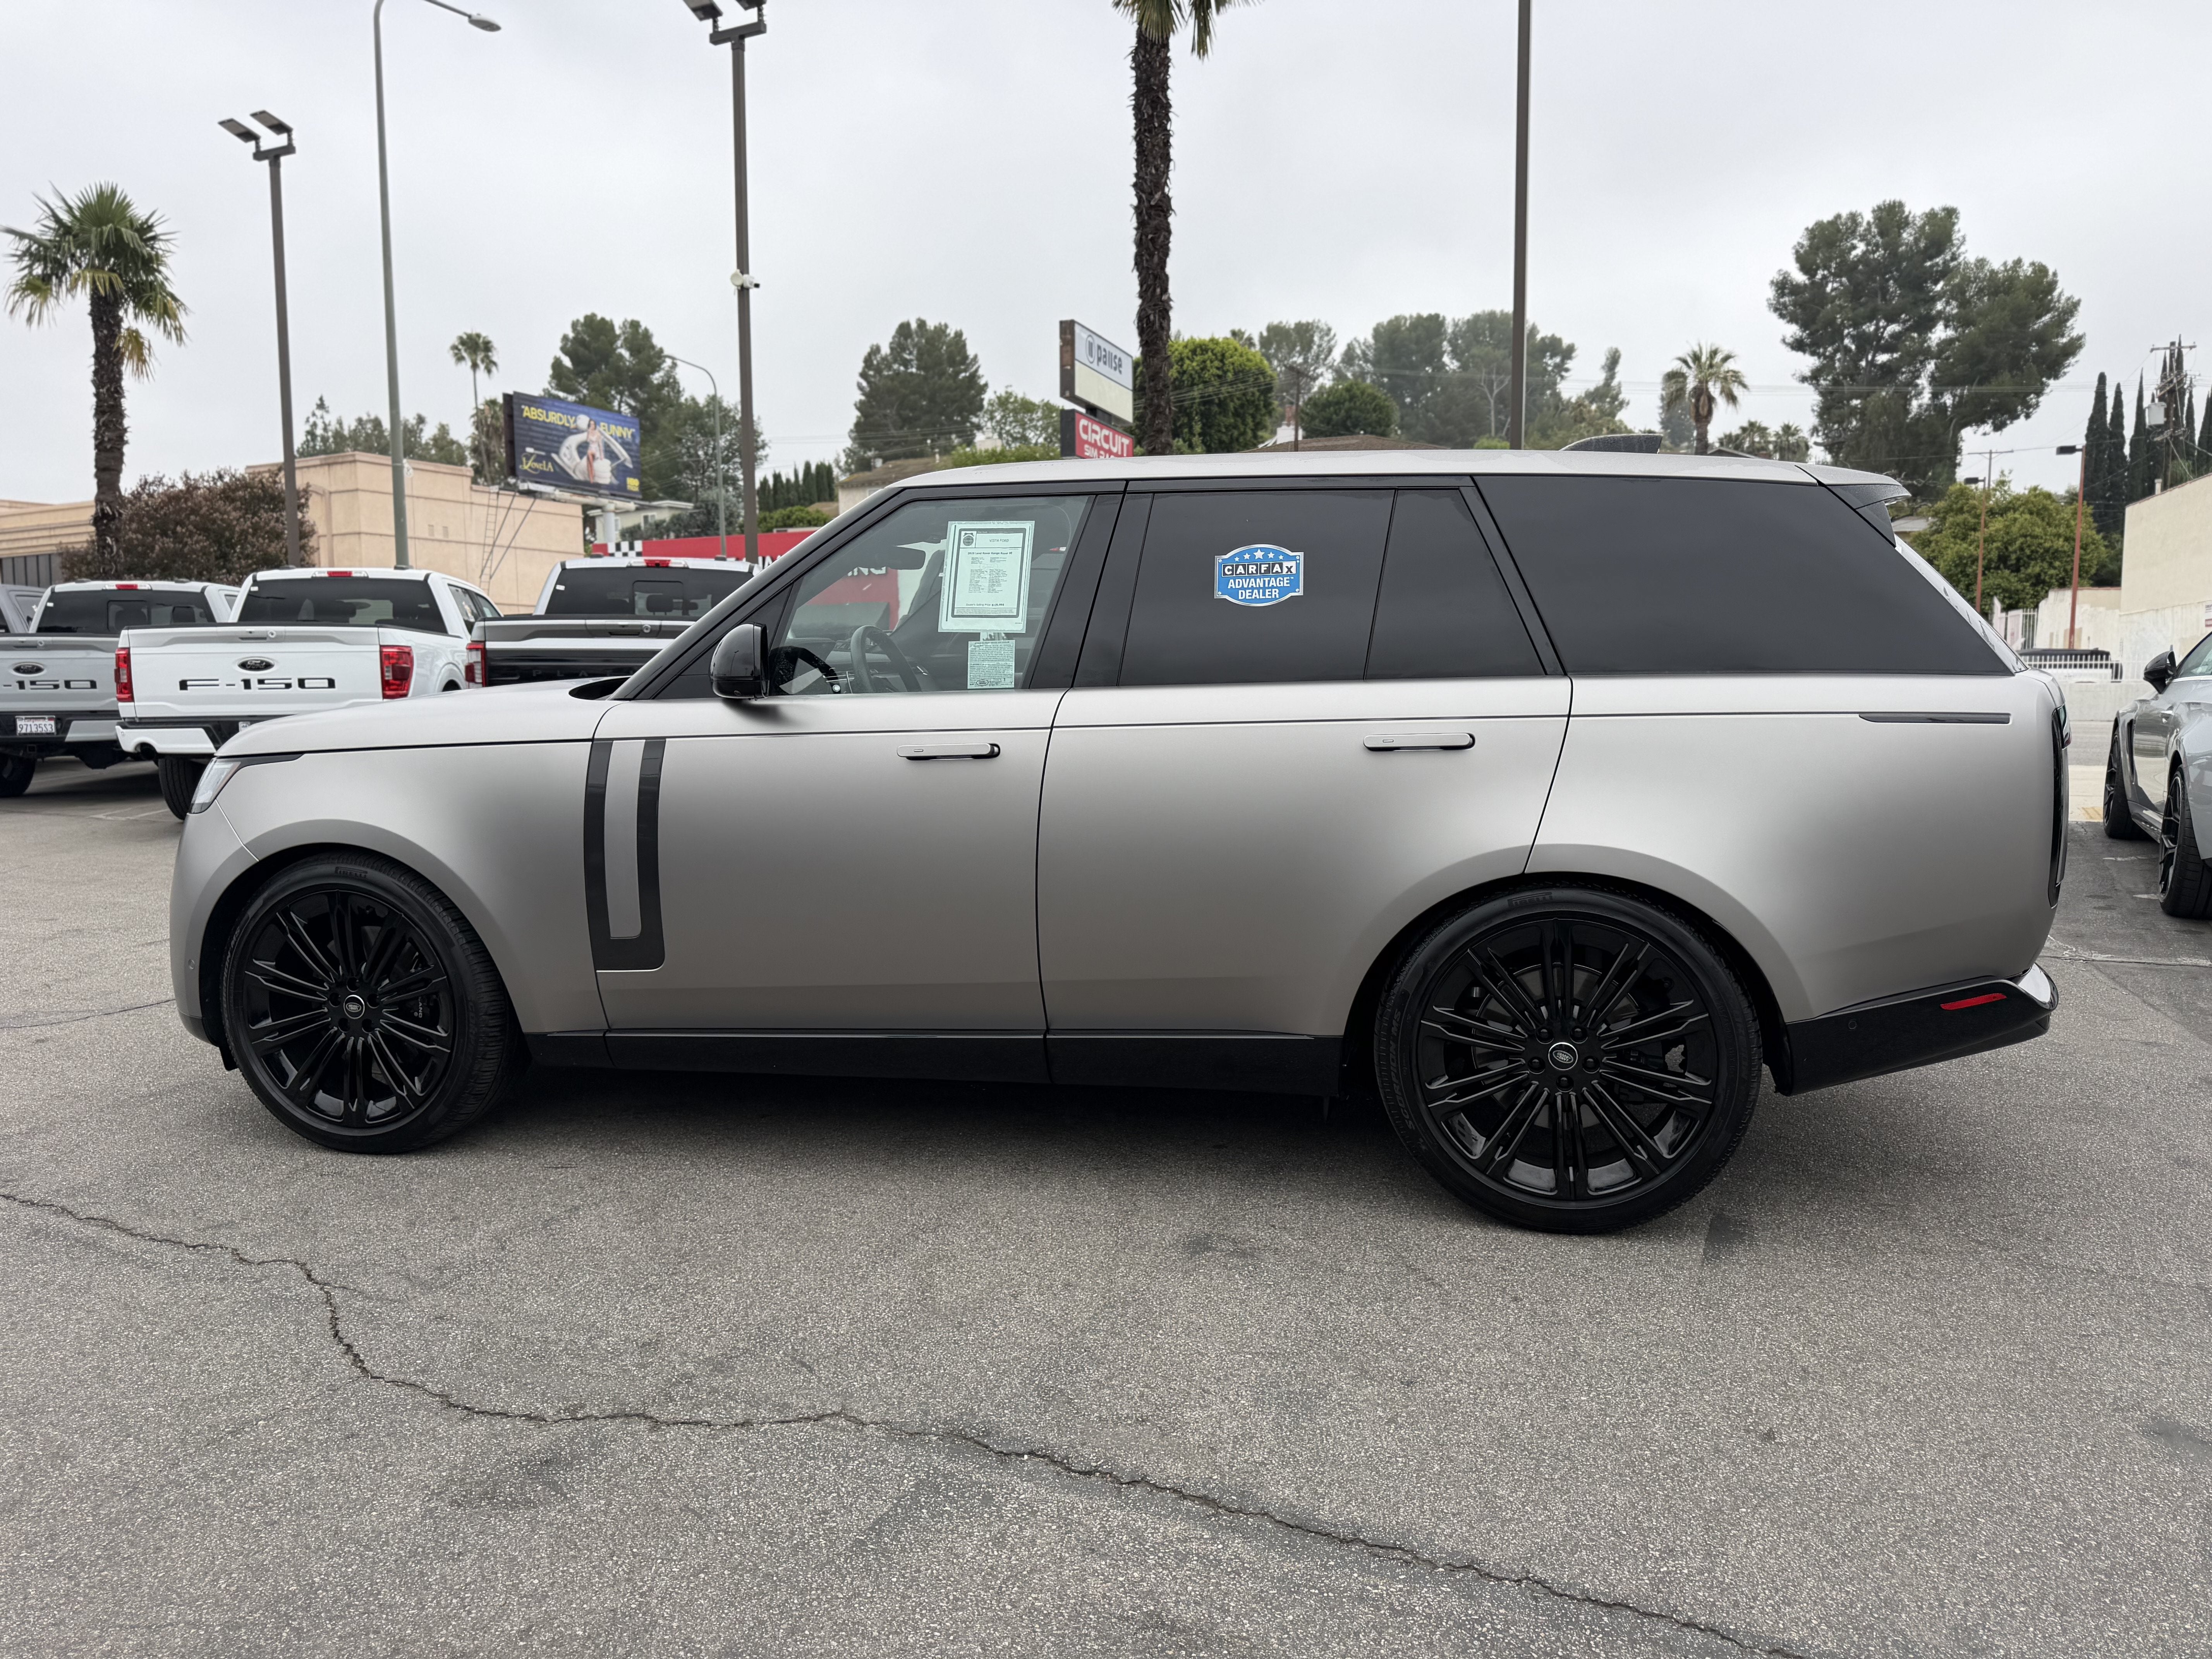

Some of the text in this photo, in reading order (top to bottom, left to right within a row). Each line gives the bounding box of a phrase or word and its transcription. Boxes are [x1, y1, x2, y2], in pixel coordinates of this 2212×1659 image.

[1079, 419, 1130, 457] CIRCUIT
[1224, 563, 1294, 575] CARFAX
[1238, 589, 1279, 599] DEALER
[246, 659, 267, 668] Ford
[3, 680, 97, 690] -150
[179, 677, 336, 691] F-150
[1389, 1008, 1416, 1130] SCORPION MS
